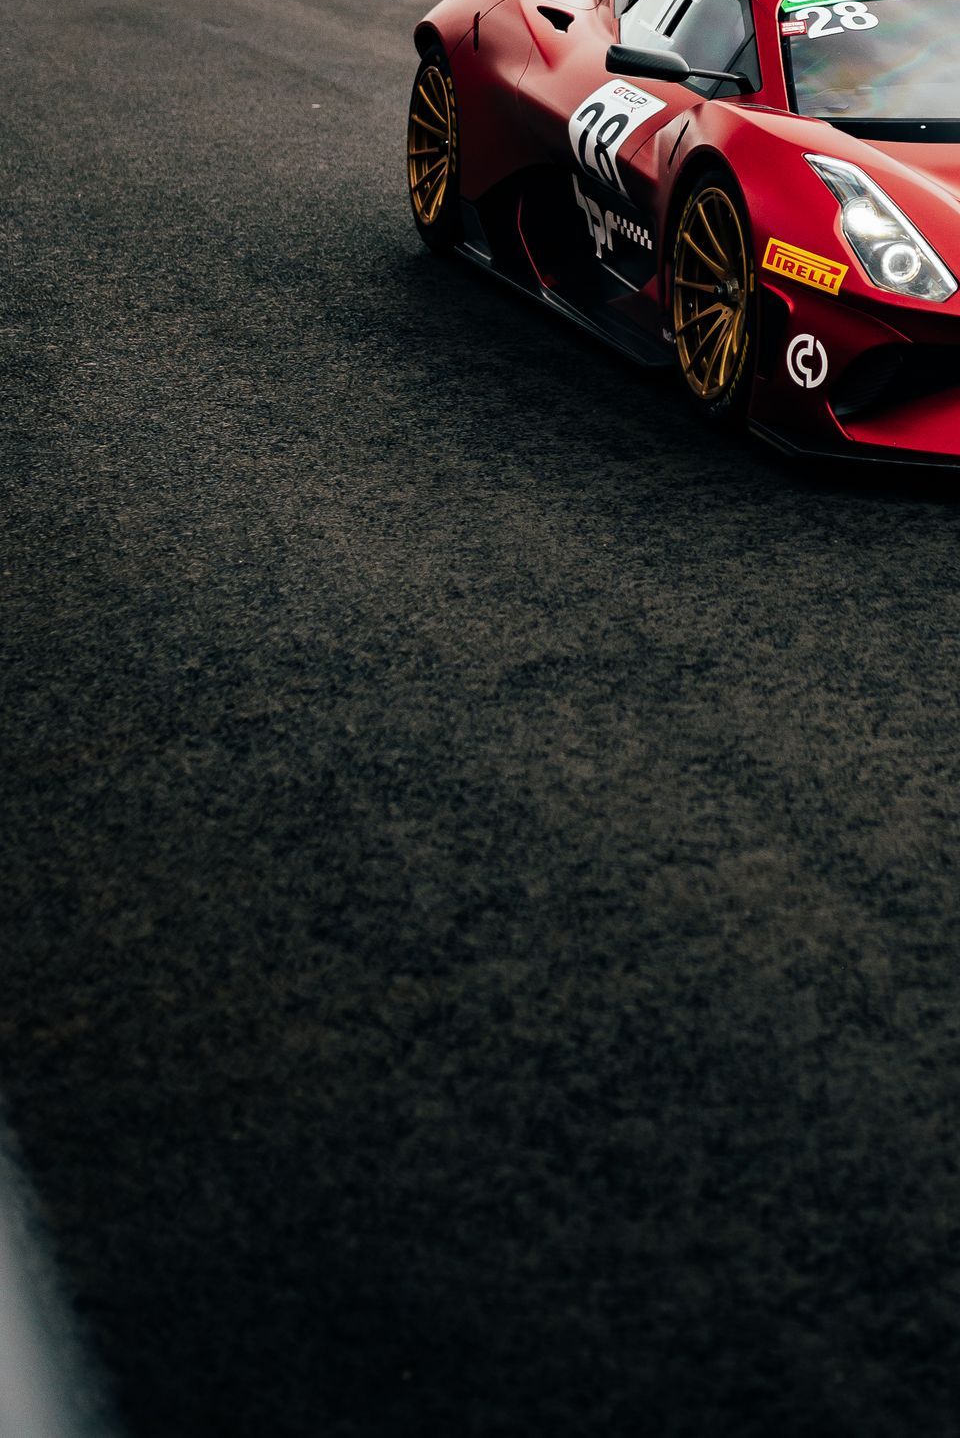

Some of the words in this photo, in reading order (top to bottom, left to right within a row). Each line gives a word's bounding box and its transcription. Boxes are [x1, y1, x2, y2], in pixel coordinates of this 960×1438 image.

[795, 0, 879, 39] 28
[577, 102, 629, 192] 28
[766, 243, 842, 290] PIRELLI
